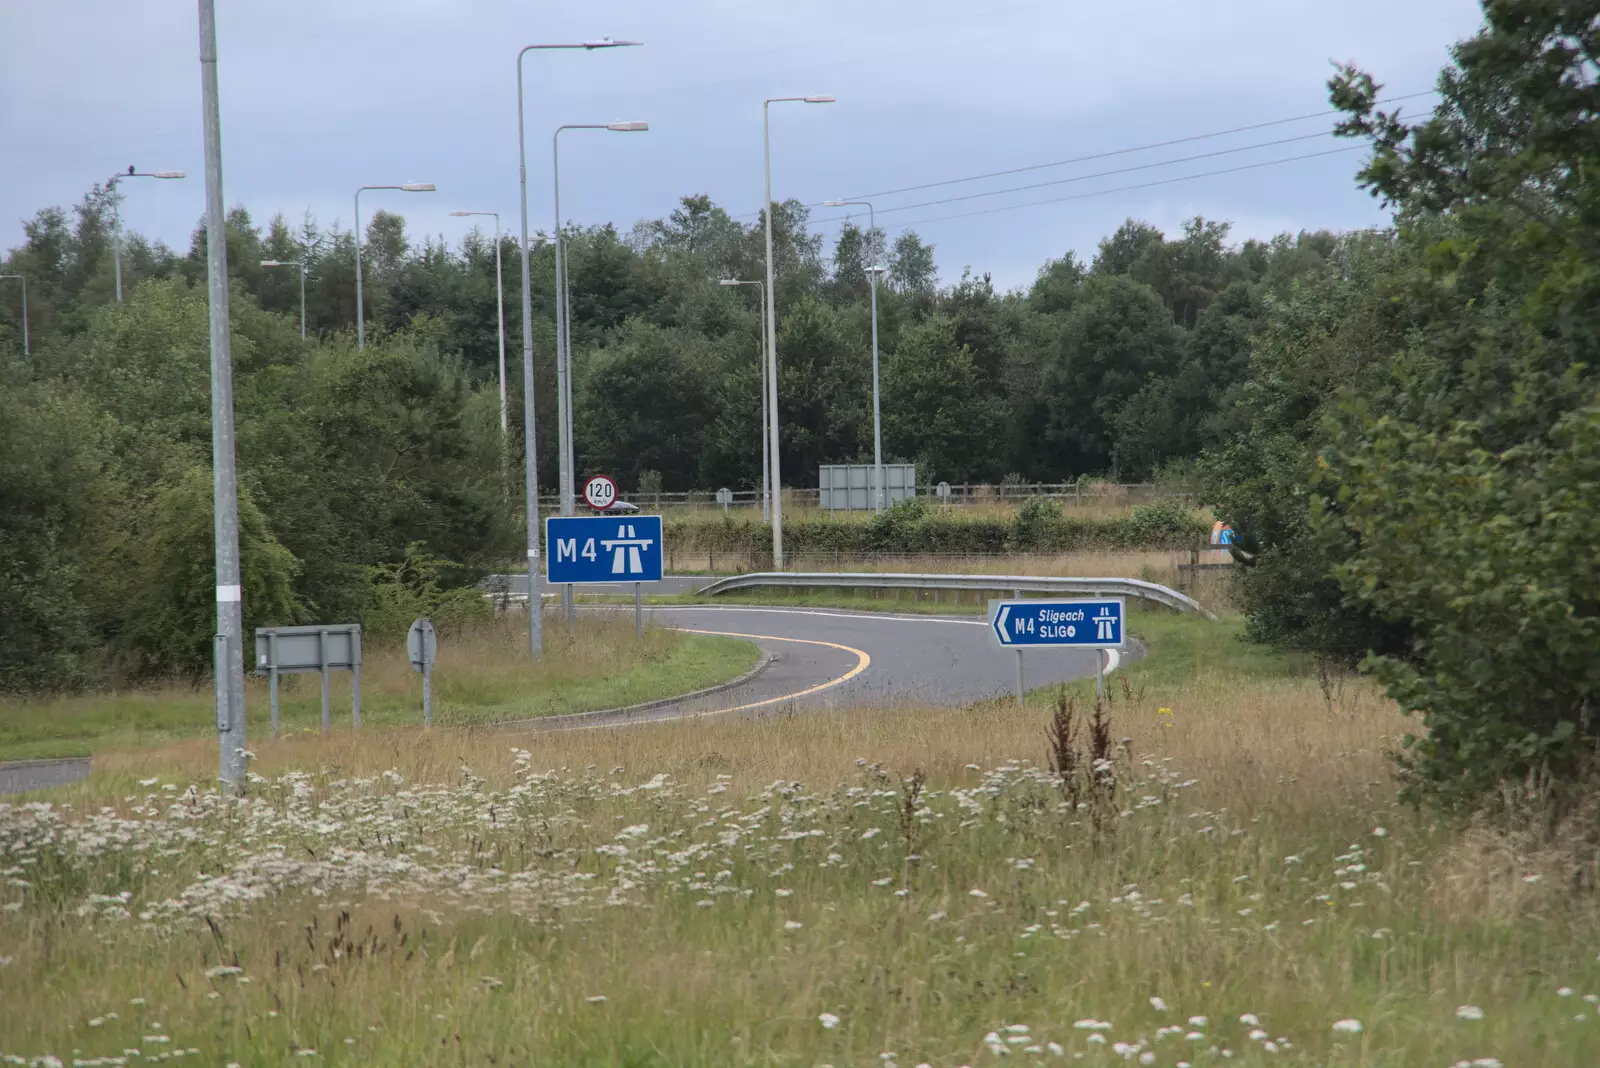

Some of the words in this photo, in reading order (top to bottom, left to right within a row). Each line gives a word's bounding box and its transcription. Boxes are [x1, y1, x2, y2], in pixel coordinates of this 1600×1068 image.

[589, 483, 612, 498] 120
[556, 538, 597, 563] M4
[1038, 609, 1085, 624] Sligeach
[1015, 617, 1035, 635] M4
[1039, 625, 1076, 638] SLIGO
